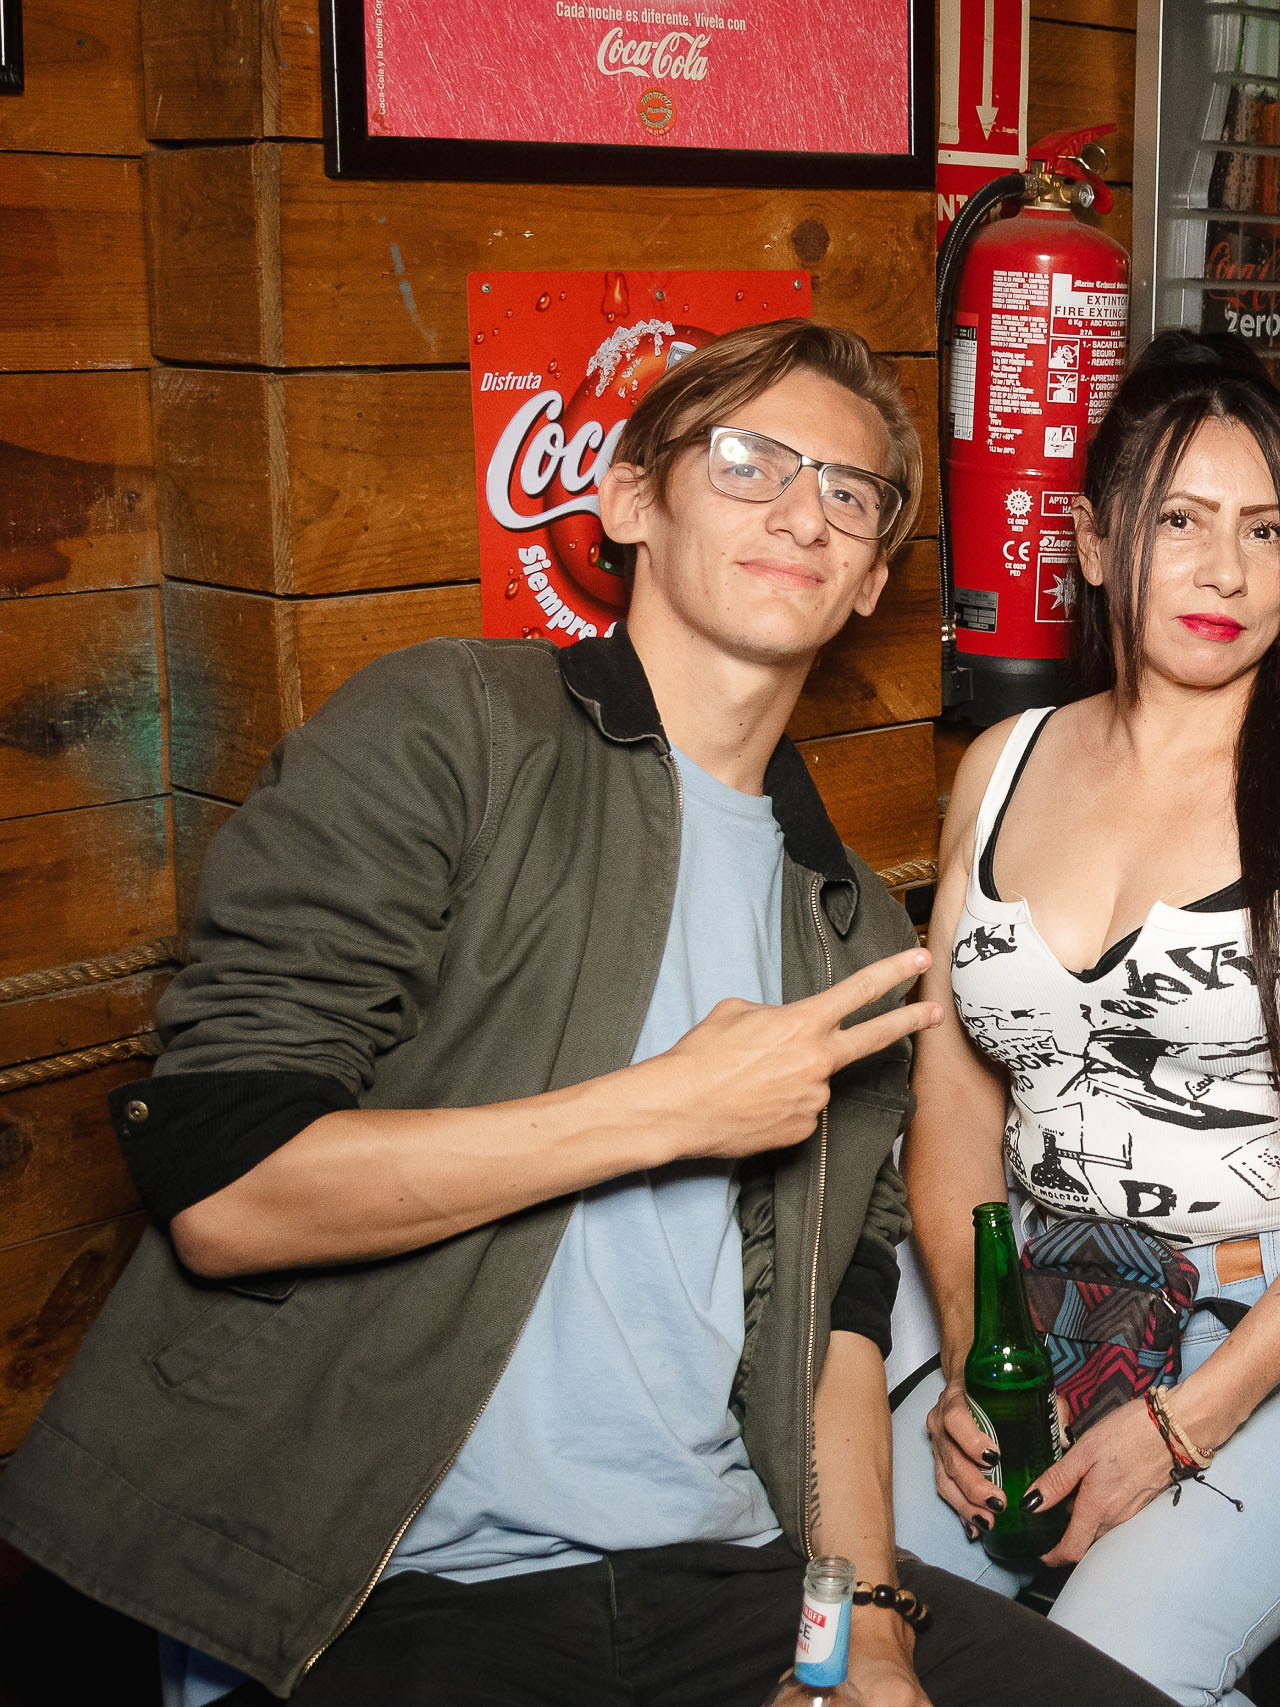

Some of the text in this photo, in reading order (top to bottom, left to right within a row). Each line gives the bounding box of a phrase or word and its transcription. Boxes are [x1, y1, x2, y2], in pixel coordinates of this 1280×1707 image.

[556, 1, 747, 31] Cada noche es diferente. Vívela con
[597, 26, 712, 81] Coca-Cola
[1055, 306, 1085, 317] FIRE
[1225, 308, 1280, 338] zero
[1092, 341, 1113, 350] SACAR
[1092, 349, 1115, 358] SEGURO
[480, 371, 542, 392] Disfruta
[1063, 428, 1073, 441] A
[1049, 496, 1068, 504] APTO
[1003, 540, 1030, 562] CE
[518, 544, 598, 639] Siempre
